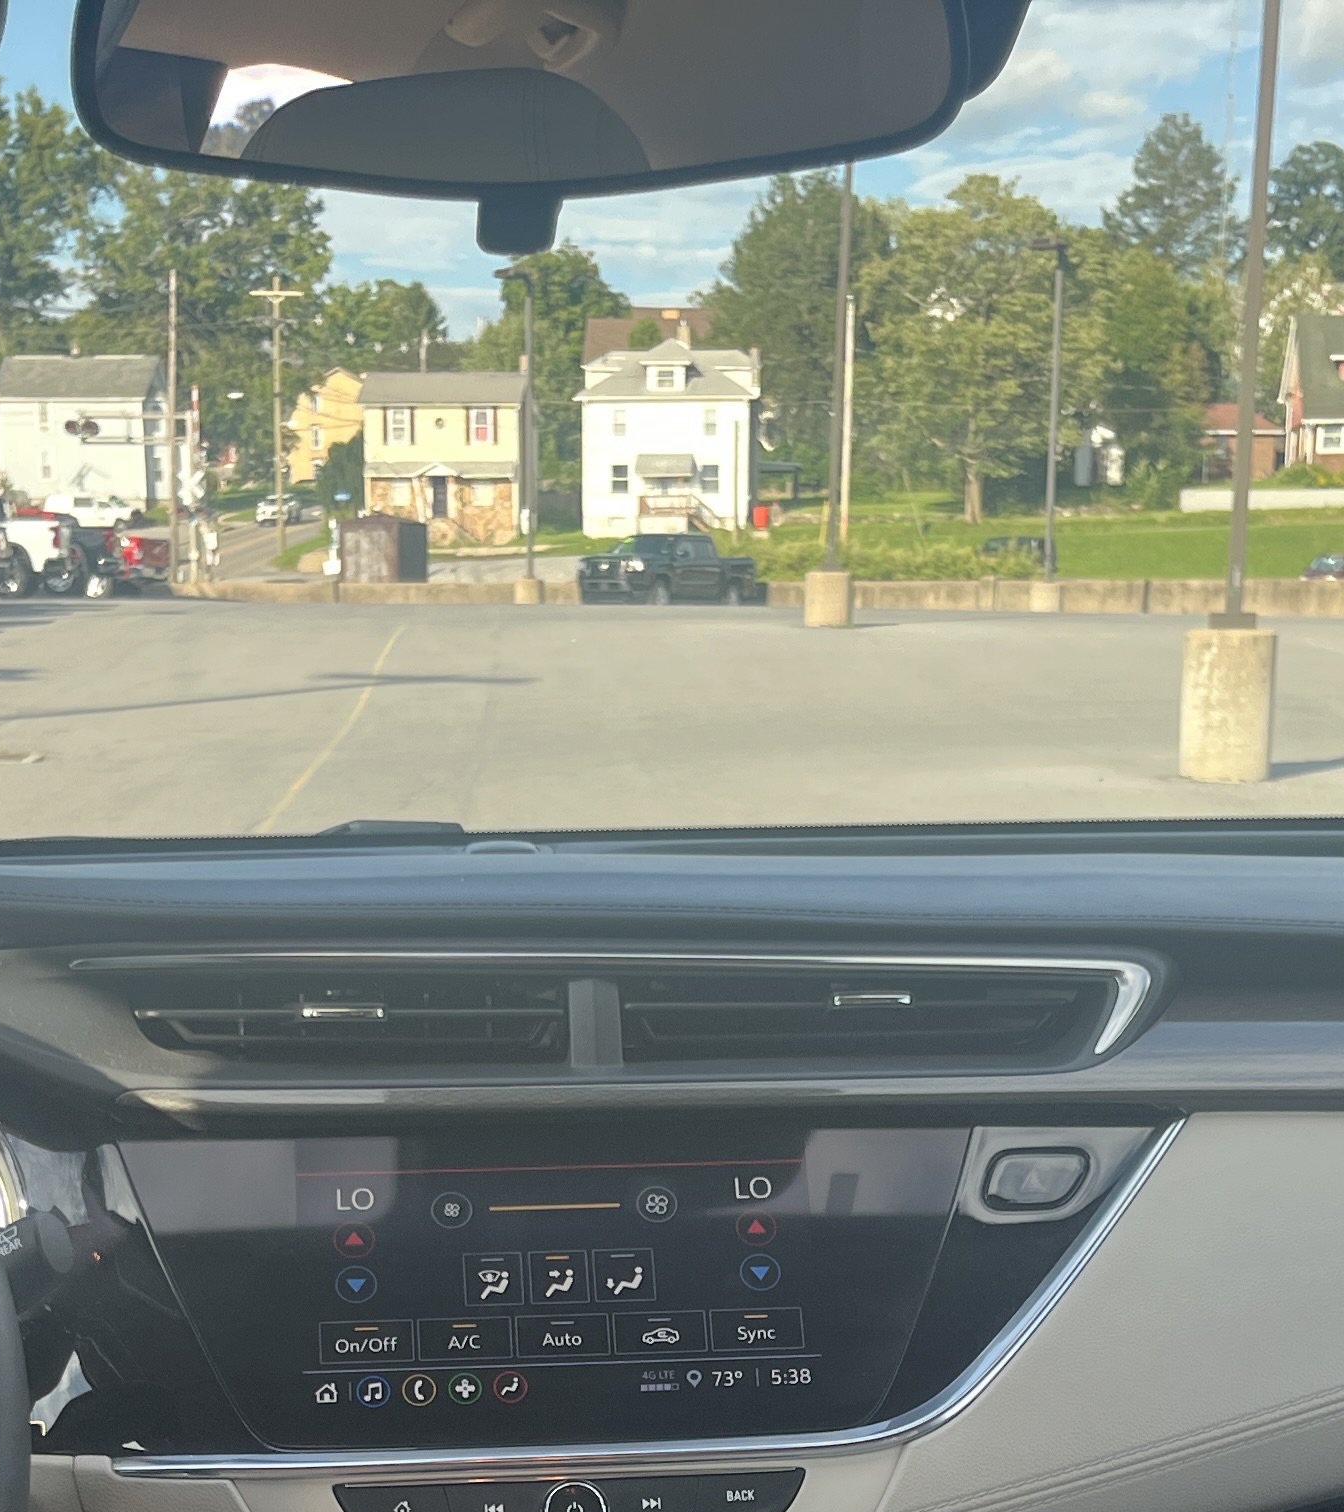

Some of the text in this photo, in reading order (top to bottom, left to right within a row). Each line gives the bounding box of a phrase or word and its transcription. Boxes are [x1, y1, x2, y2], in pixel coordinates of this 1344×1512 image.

[734, 1176, 772, 1199] LO
[336, 1188, 375, 1211] LO
[447, 1335, 481, 1350] A/C
[542, 1332, 583, 1347] Auto
[737, 1326, 777, 1344] Sync
[335, 1336, 398, 1354] On/Off
[642, 1370, 676, 1380] 4G LTE
[771, 1368, 812, 1385] 5:38
[726, 1489, 755, 1502] BACK
